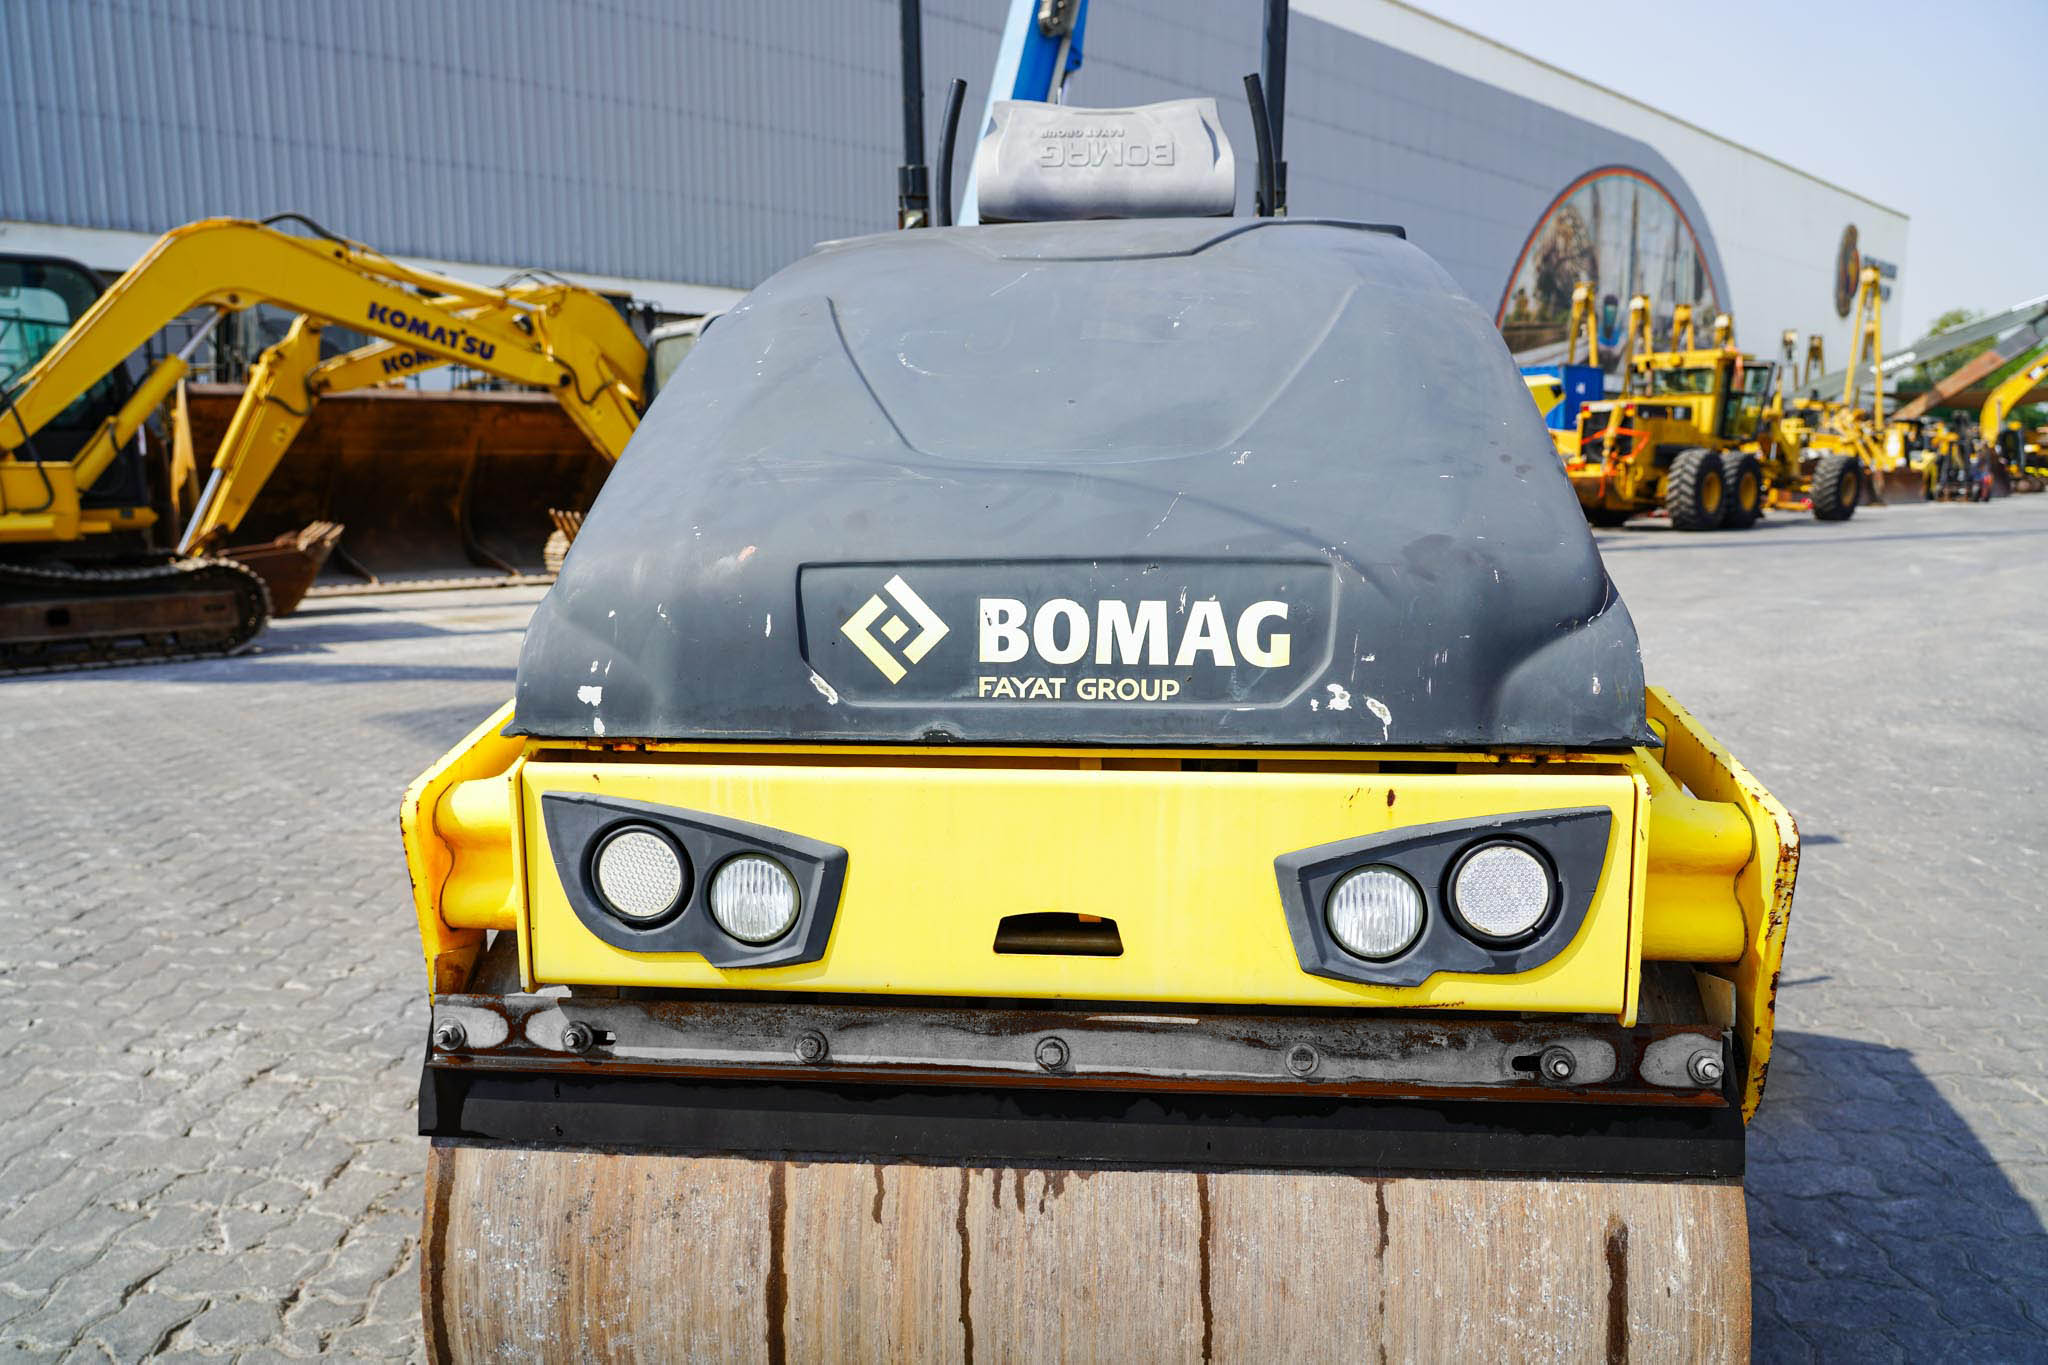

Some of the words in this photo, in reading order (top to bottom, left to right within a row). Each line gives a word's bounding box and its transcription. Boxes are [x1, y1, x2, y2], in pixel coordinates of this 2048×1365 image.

[1040, 128, 1084, 138] GROUP
[1085, 128, 1125, 138] FAYAT
[1040, 141, 1175, 168] BOMAG
[368, 301, 495, 360] KOMATSU
[979, 598, 1291, 668] BOMAG
[978, 676, 1066, 699] FAYAT
[1076, 677, 1180, 701] GROUP
